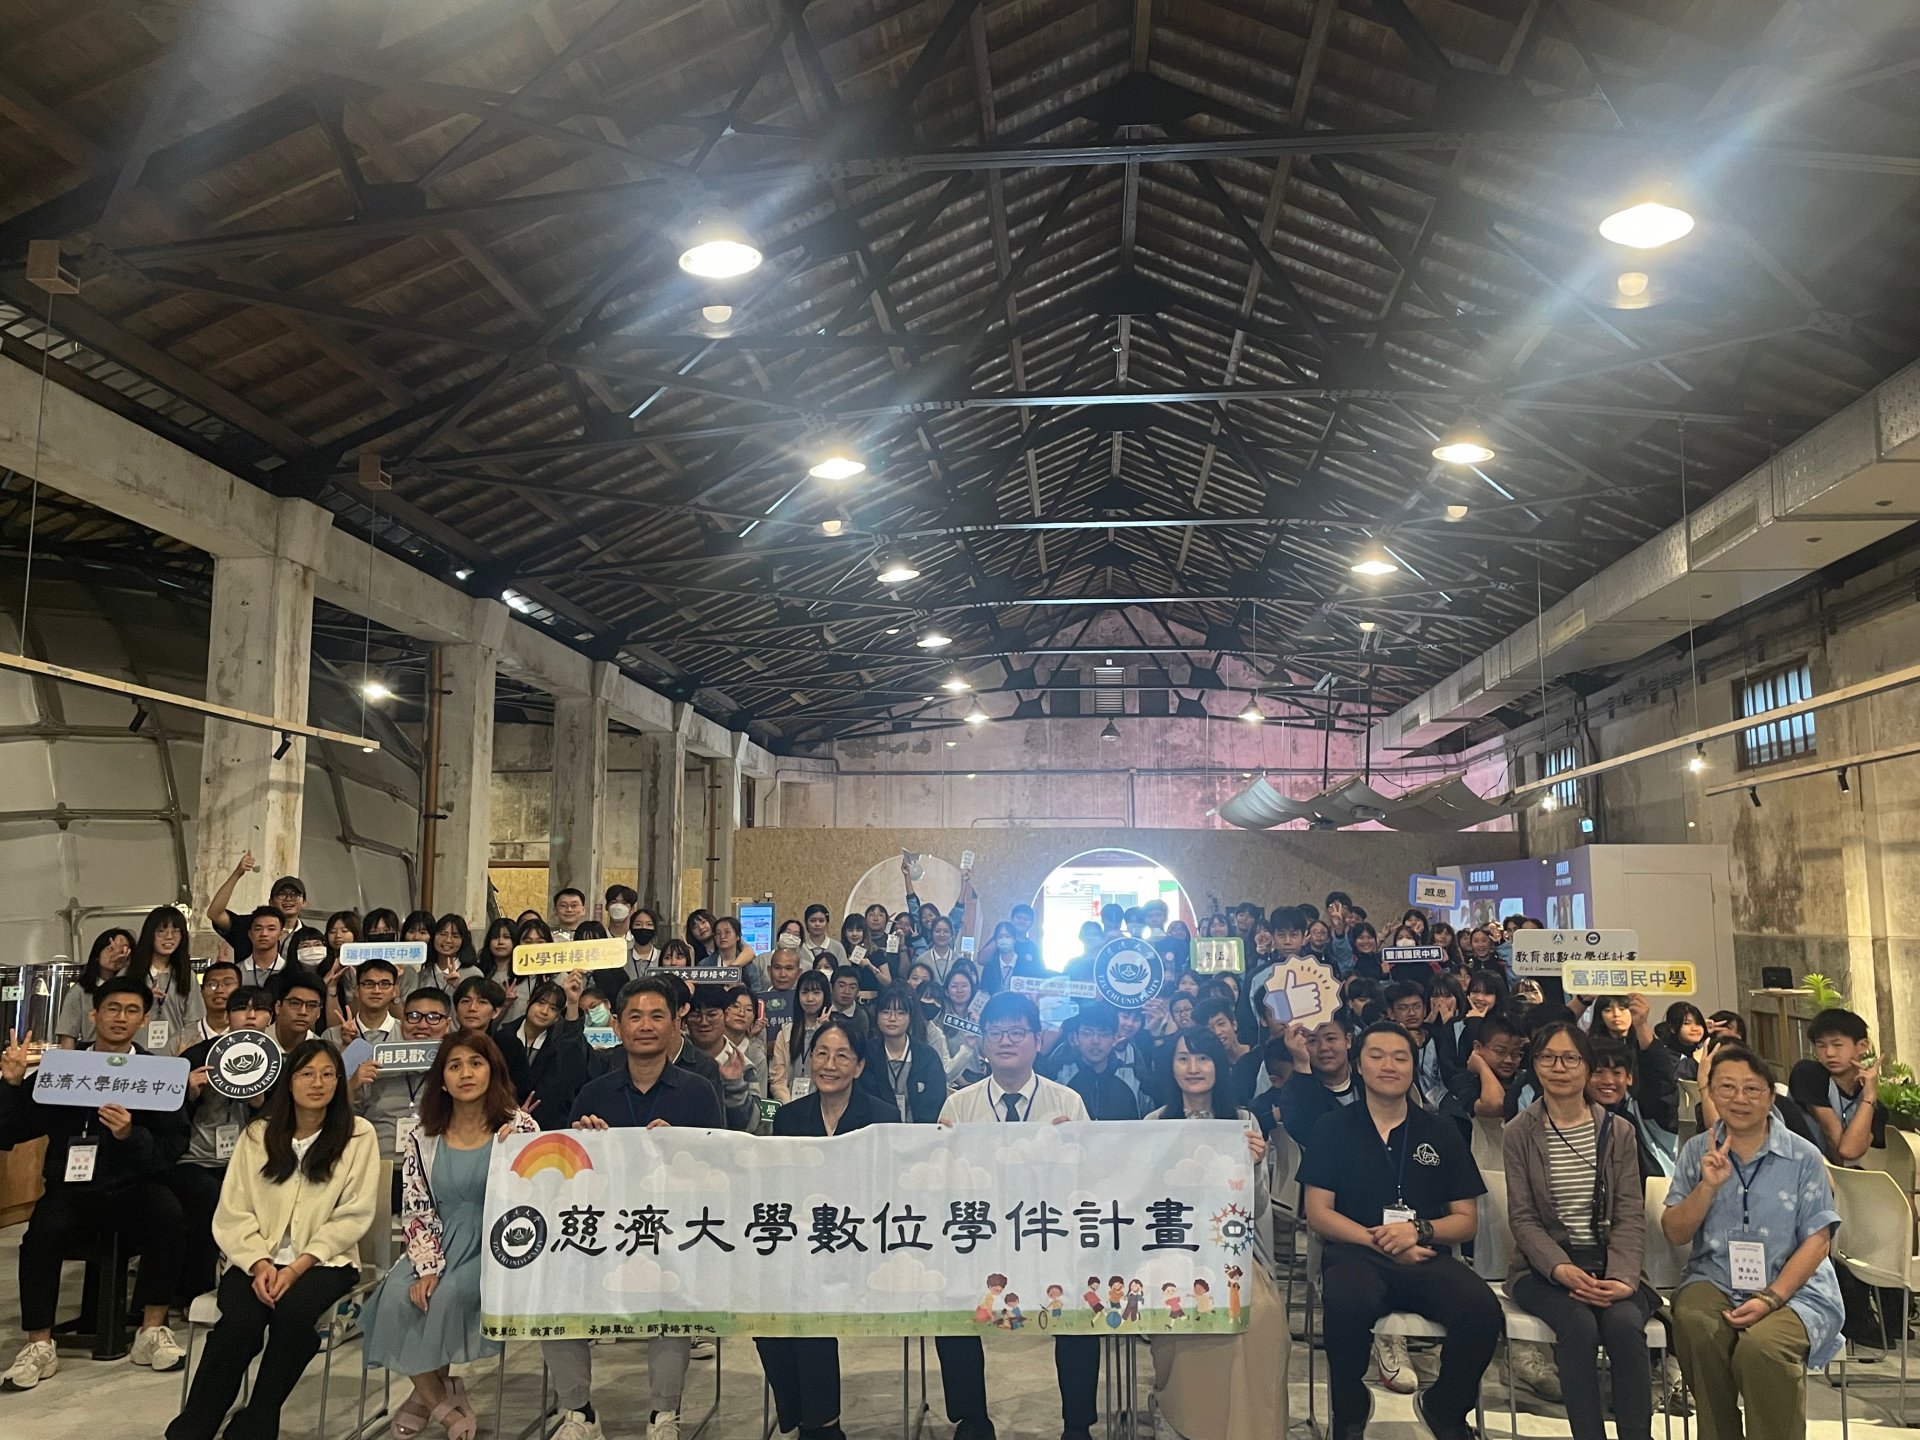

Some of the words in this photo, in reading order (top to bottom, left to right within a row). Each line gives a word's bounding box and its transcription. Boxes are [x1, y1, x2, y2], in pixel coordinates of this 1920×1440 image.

[519, 945, 622, 967] 小學伴棒棒
[1572, 970, 1687, 988] 富源國民中學
[590, 1032, 619, 1043] 大學
[377, 1048, 426, 1065] 相見歡
[37, 1071, 185, 1095] 慈濟大學師培中心
[212, 1073, 226, 1088] TZU
[225, 1086, 240, 1094] CHI
[242, 1060, 279, 1094] UNIVERSITY
[550, 1197, 1200, 1258] 慈濟大學數位學伴計畫
